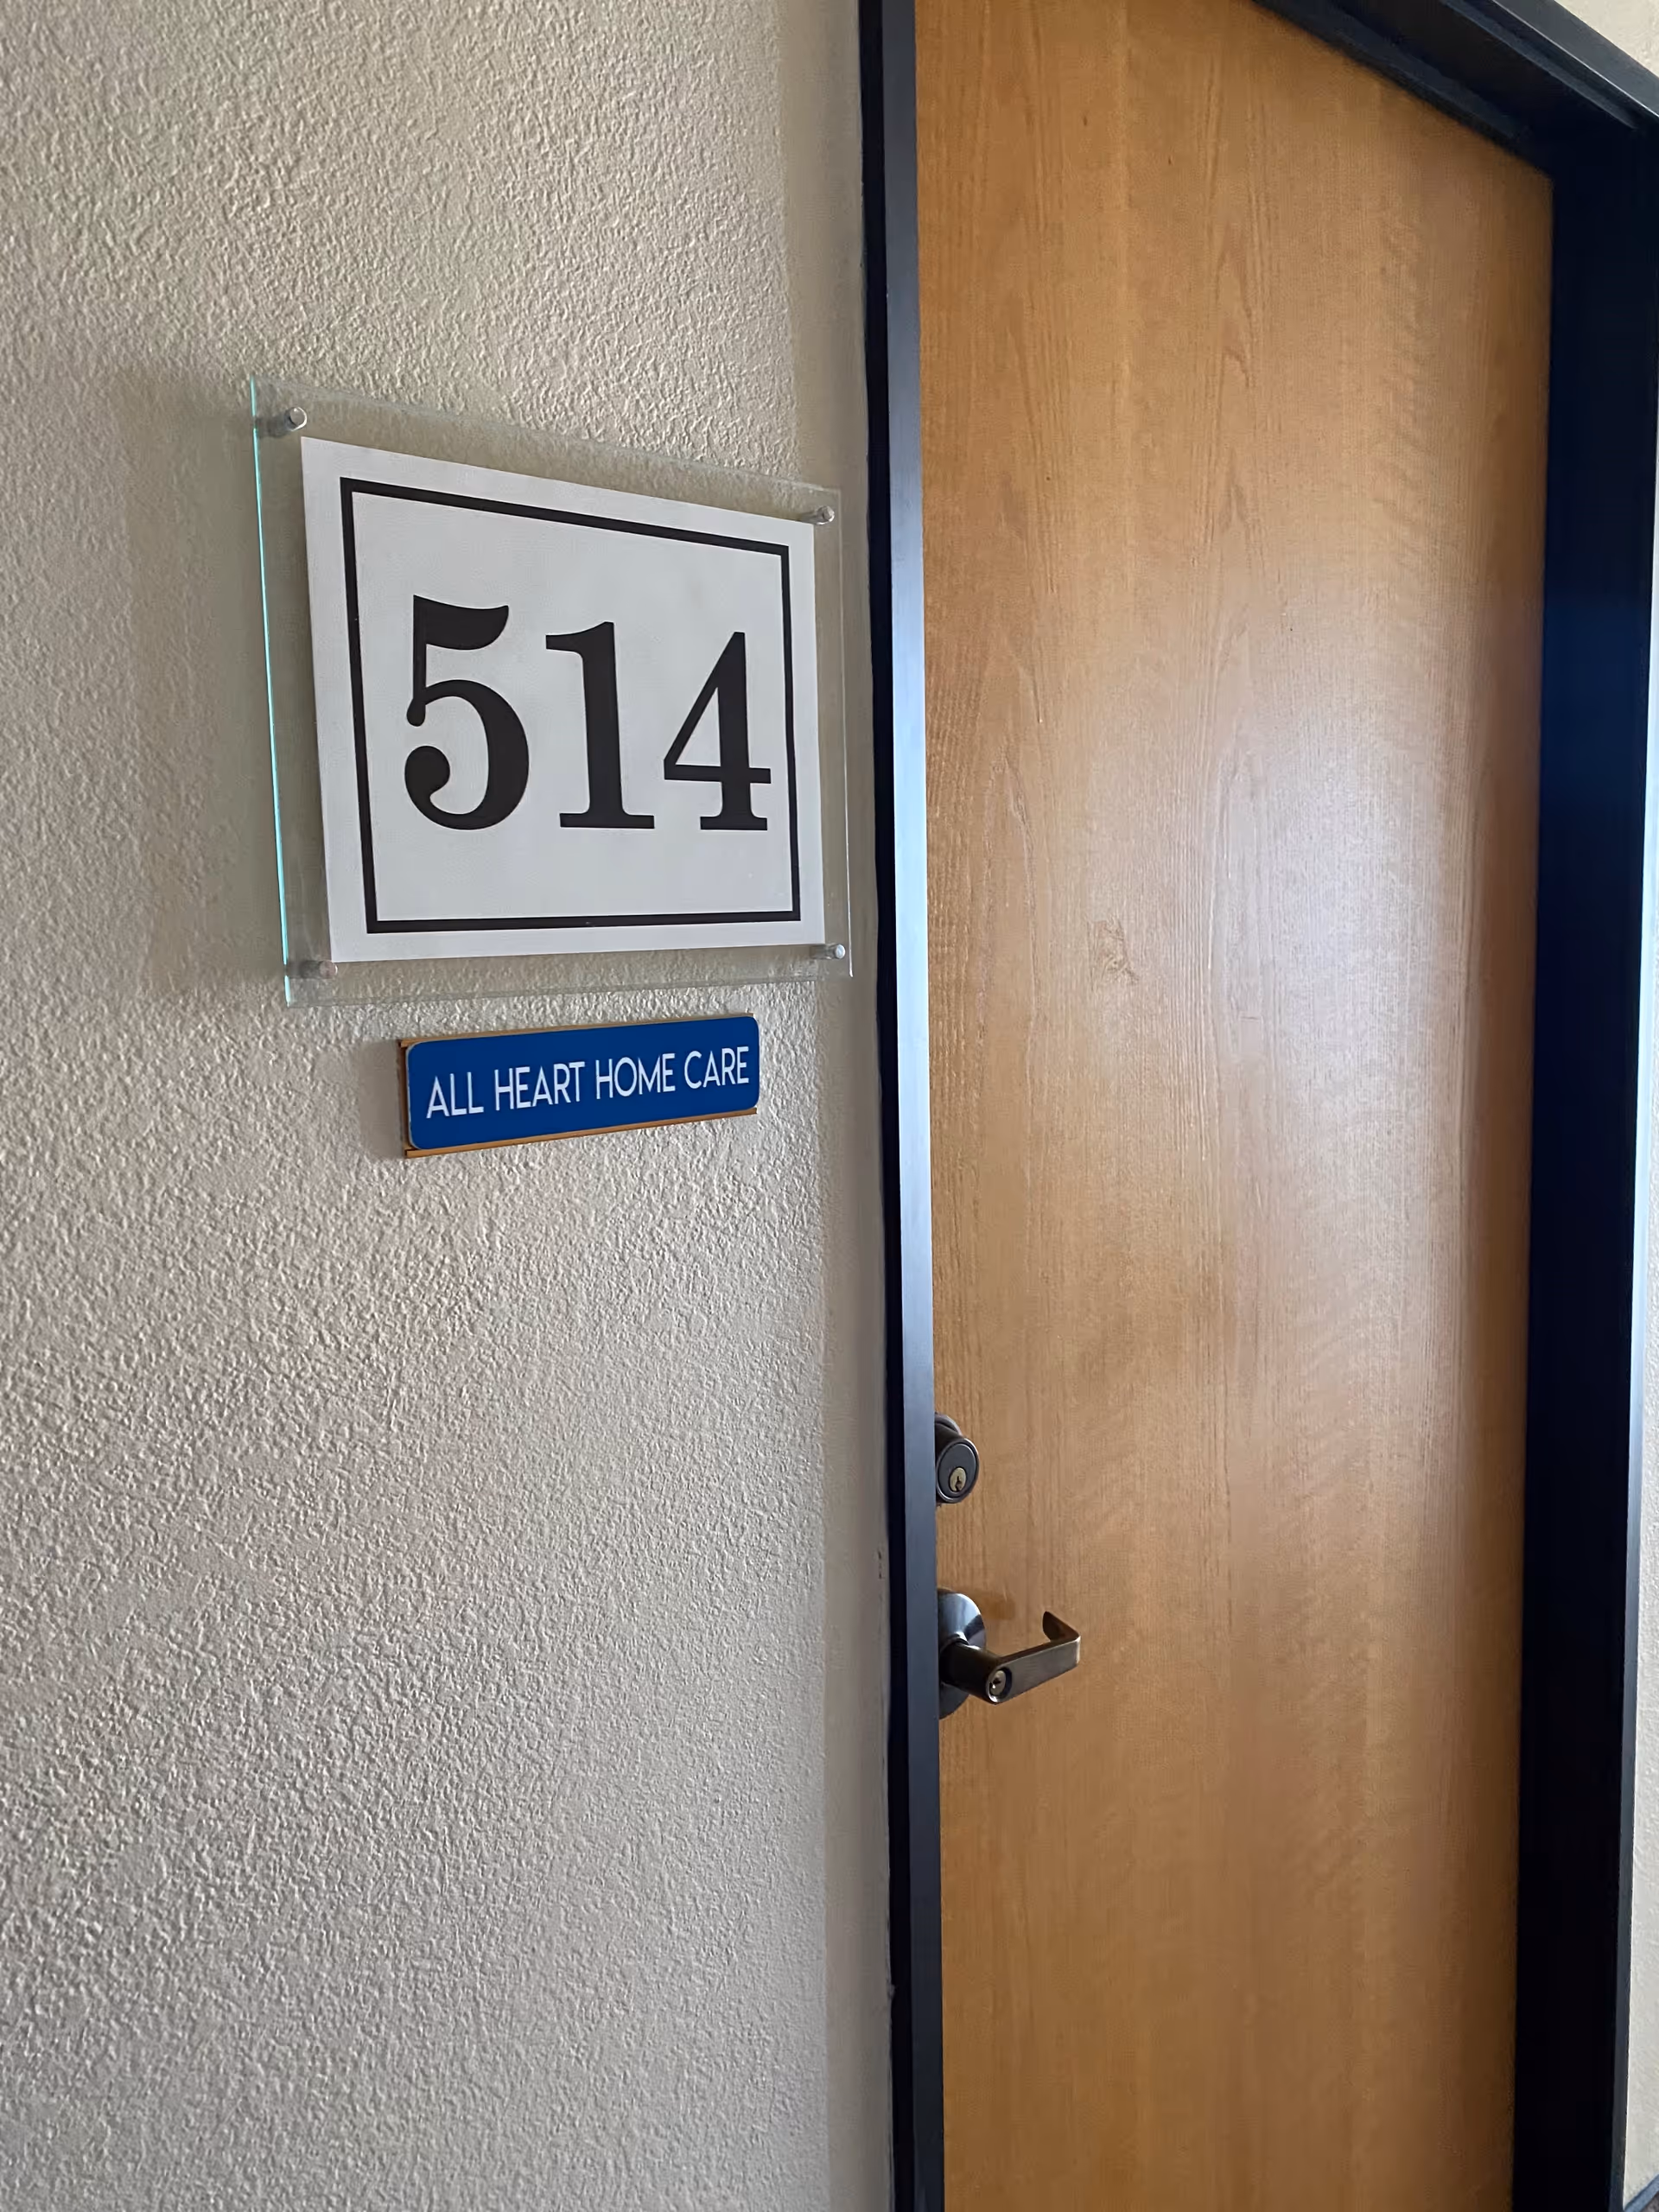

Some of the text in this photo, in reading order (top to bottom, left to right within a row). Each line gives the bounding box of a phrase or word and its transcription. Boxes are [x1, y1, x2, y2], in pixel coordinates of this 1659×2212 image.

[404, 595, 772, 830] 514
[426, 1046, 749, 1119] ALL HEART HOME CARE
